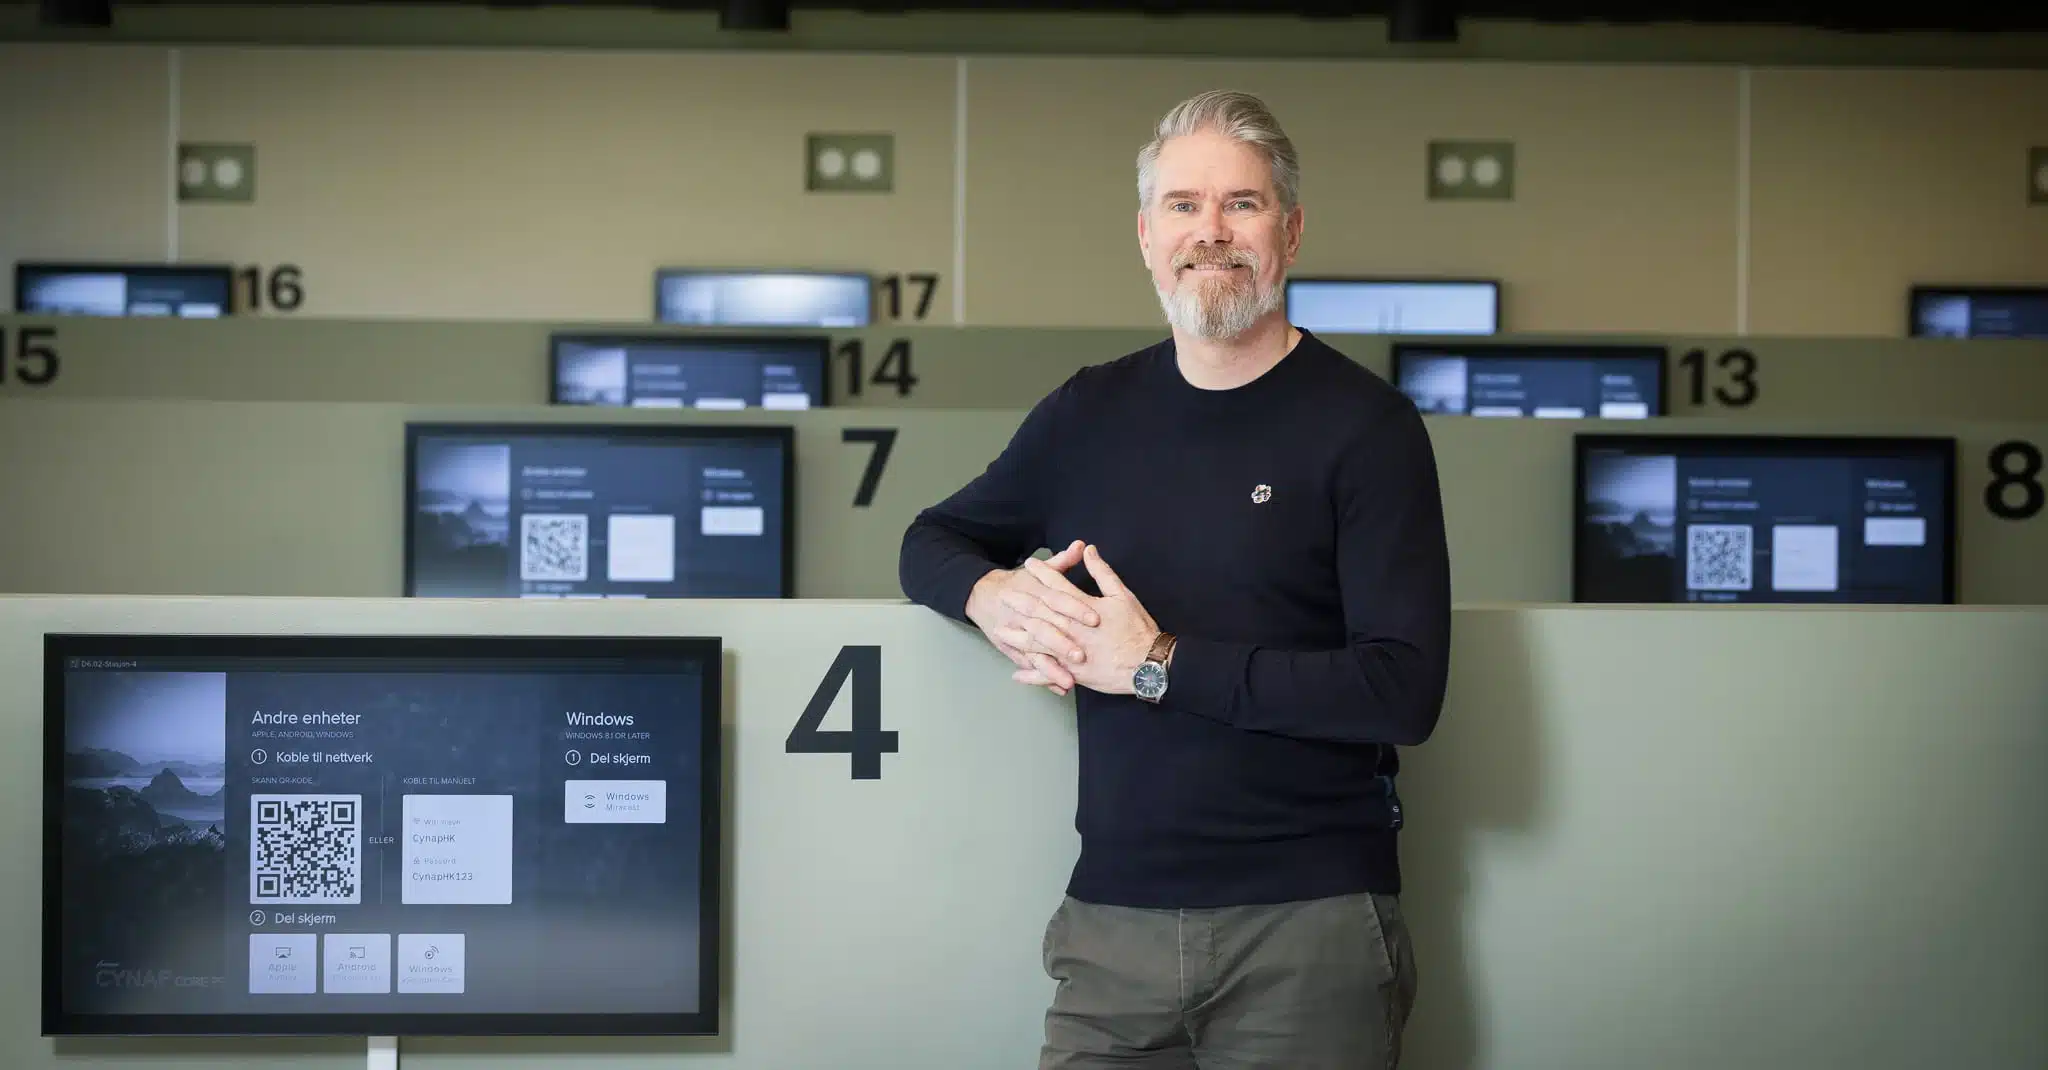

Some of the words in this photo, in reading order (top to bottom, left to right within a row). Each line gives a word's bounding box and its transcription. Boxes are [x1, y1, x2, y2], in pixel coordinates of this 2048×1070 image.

[240, 264, 303, 309] 16
[880, 275, 939, 318] 17
[837, 339, 919, 397] 14
[1680, 348, 1758, 407] 13
[842, 429, 899, 506] 7
[1984, 440, 2045, 520] 8
[252, 711, 298, 725] Andre
[303, 711, 361, 725] enheter
[566, 712, 634, 726] Windows
[785, 645, 899, 780] 4
[316, 731, 354, 739] WINDOWS
[565, 731, 603, 740] WINDOWS
[627, 732, 650, 740] LATER
[276, 752, 310, 763] Koble
[313, 752, 322, 763] til
[325, 752, 373, 763] nettverk
[590, 753, 610, 764] Del
[613, 753, 651, 766] skjerm
[251, 776, 277, 785] SKANN
[403, 777, 427, 785] KOBLE
[429, 777, 440, 785] TIL
[440, 777, 477, 785] MANUELT
[606, 792, 649, 801] Windows
[369, 836, 395, 844] ELLER
[412, 834, 456, 845] CynapHK
[412, 872, 474, 882] CynapHK123
[275, 913, 295, 924] Del
[298, 913, 336, 926] skjerm
[408, 964, 453, 973] Windows
